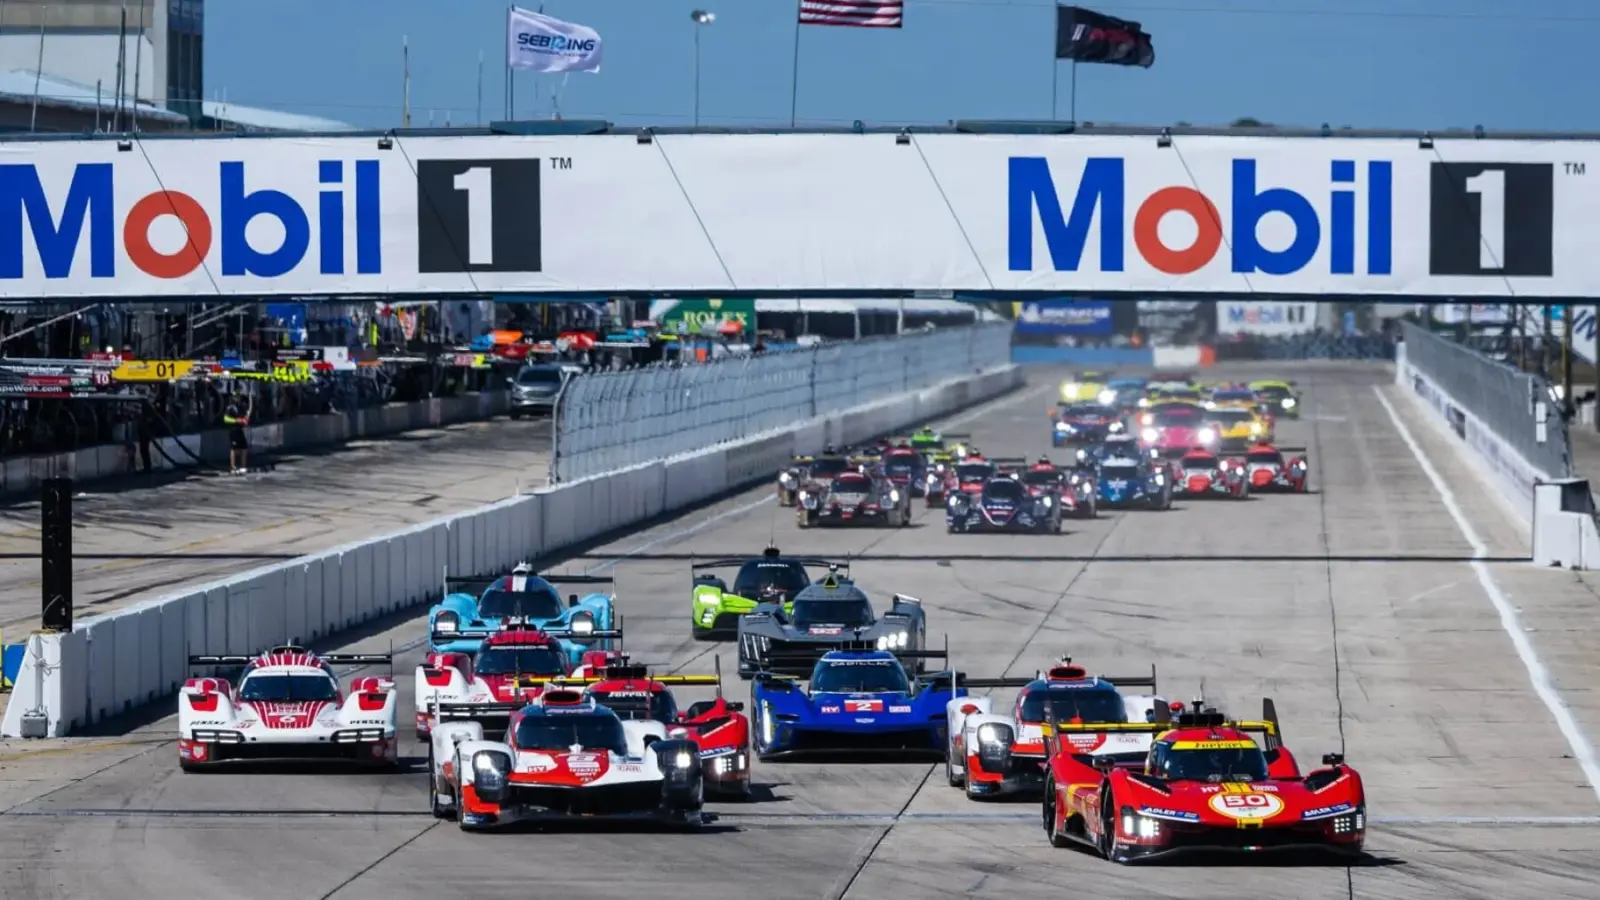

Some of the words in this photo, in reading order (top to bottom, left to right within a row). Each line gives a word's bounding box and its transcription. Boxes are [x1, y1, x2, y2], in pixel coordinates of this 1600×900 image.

[0, 160, 382, 279] Mobil
[550, 158, 572, 169] TM
[1008, 157, 1392, 275] Mobil
[1563, 164, 1585, 174] TM
[683, 311, 747, 326] ROLEX
[156, 363, 176, 377] 01
[95, 374, 109, 384] 10
[856, 703, 873, 711] 2
[1224, 795, 1266, 806] 50
[1144, 807, 1176, 816] ADLER
